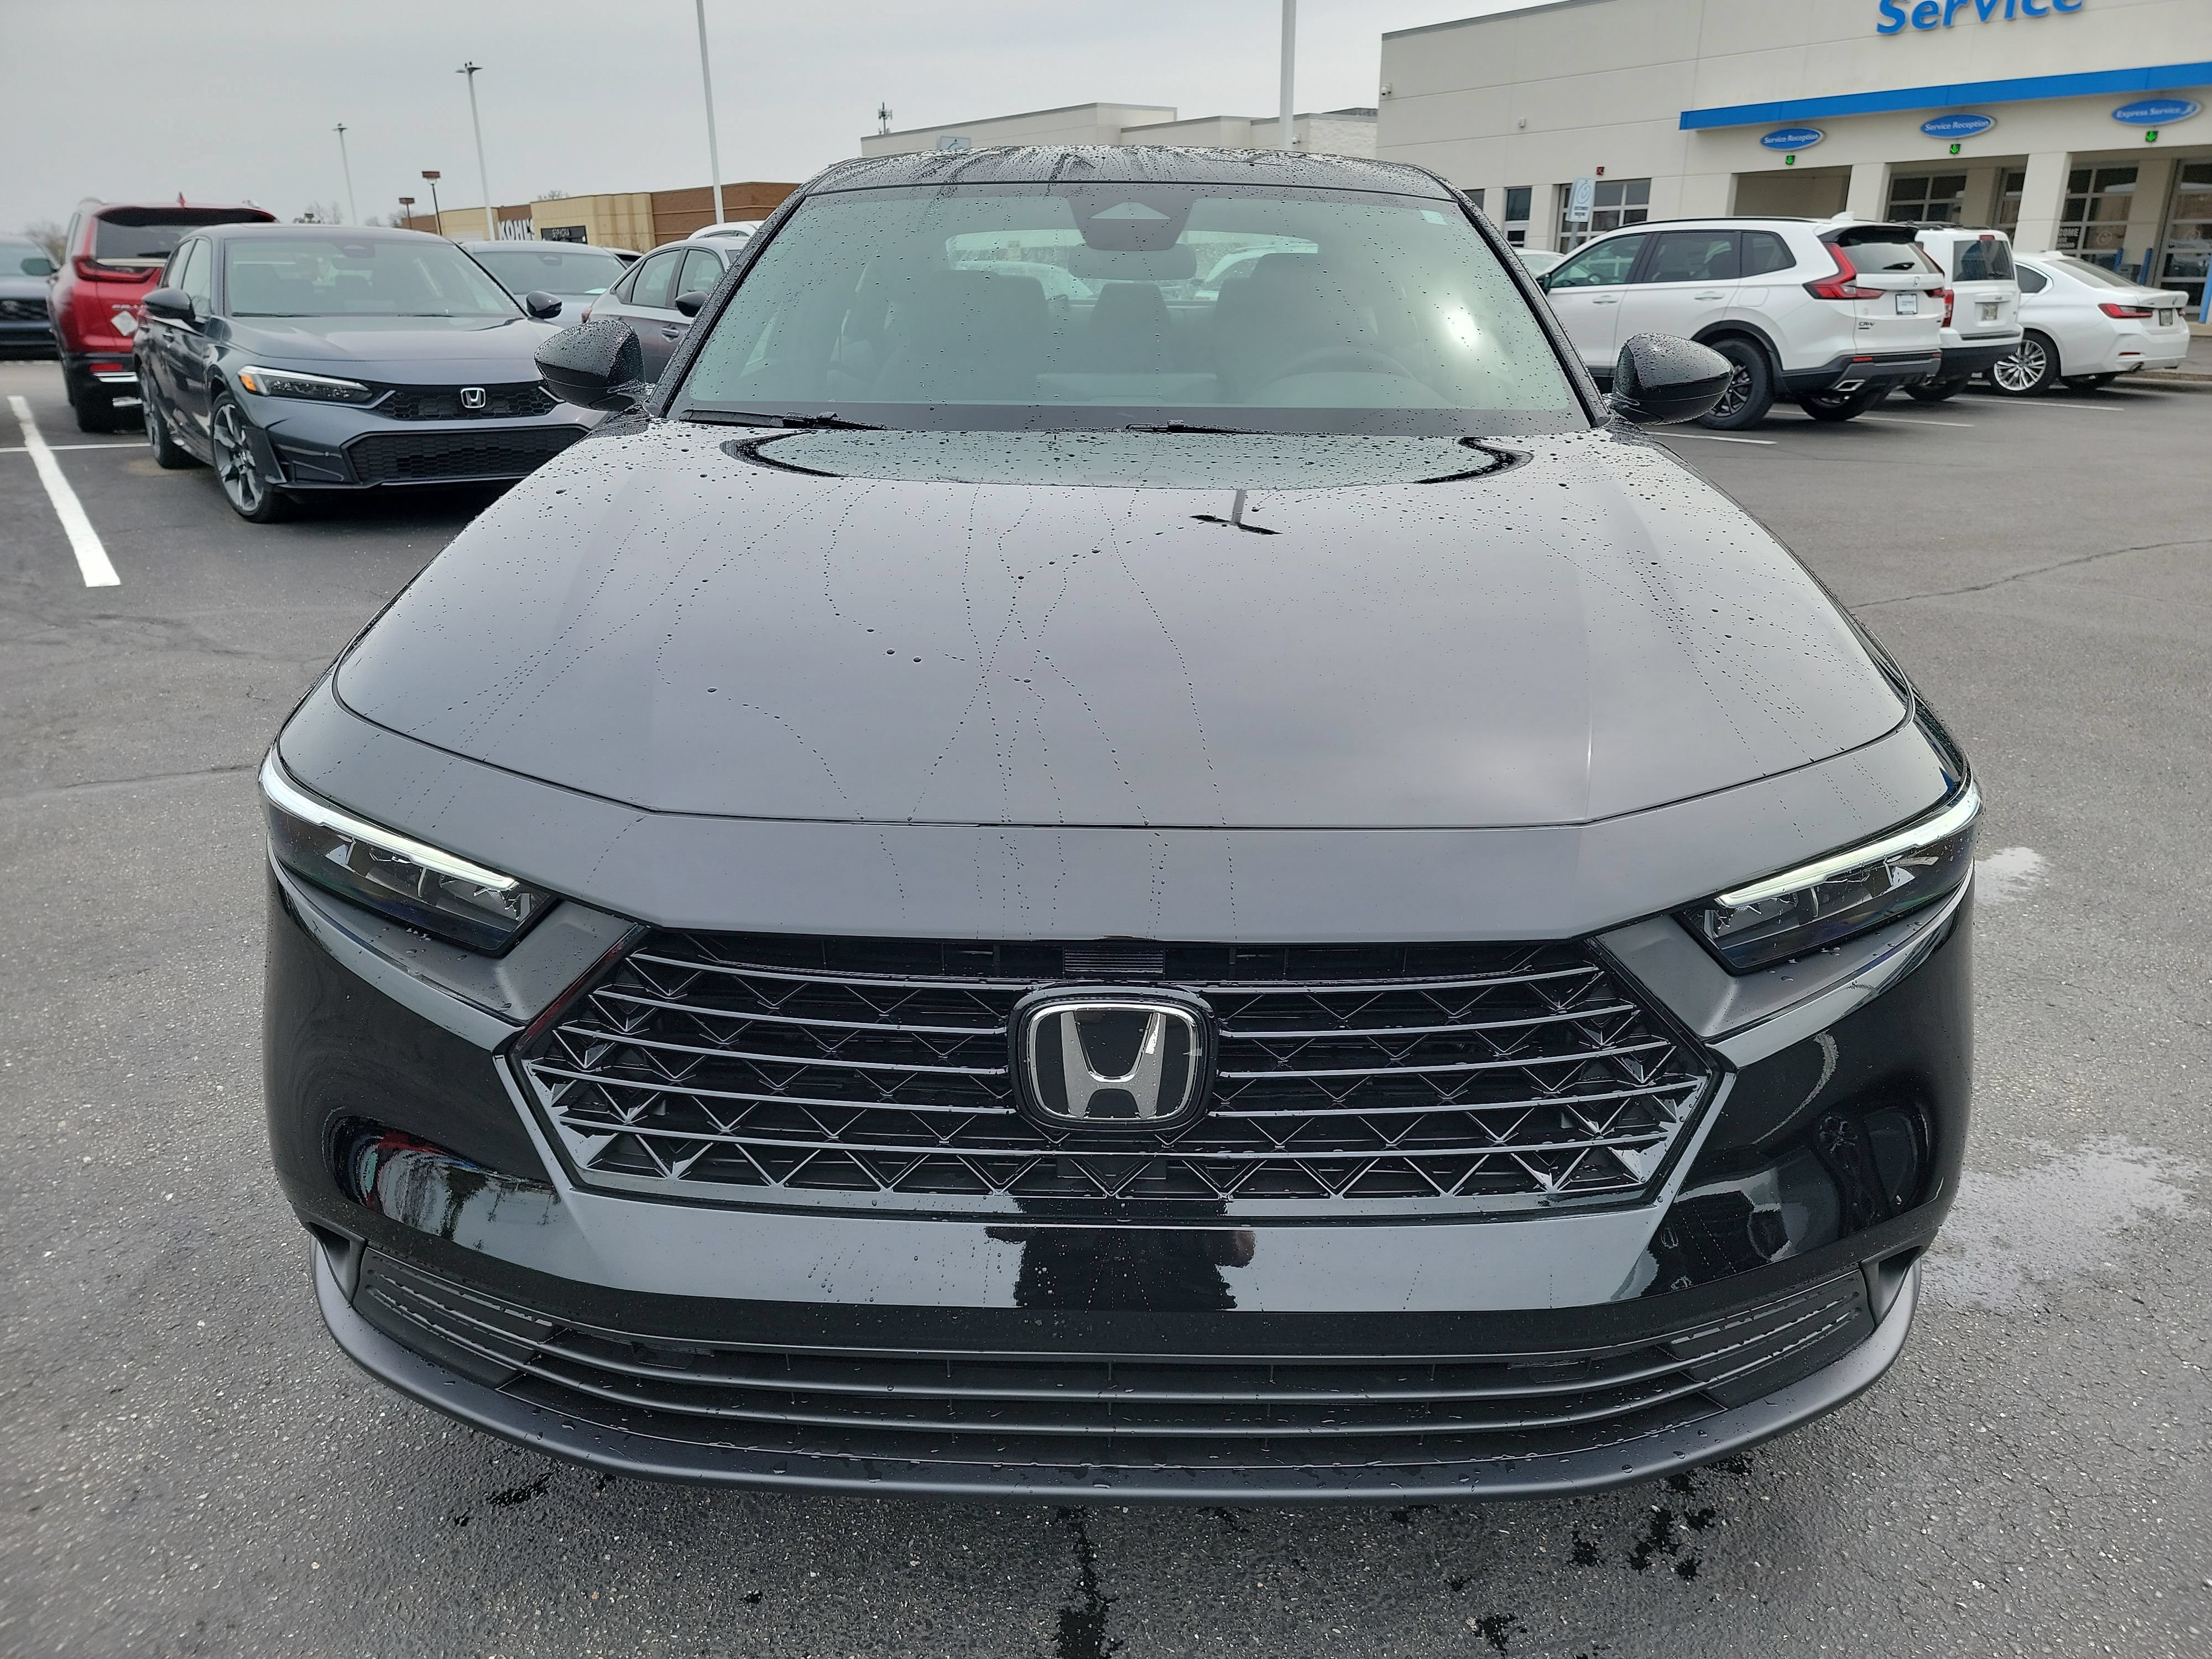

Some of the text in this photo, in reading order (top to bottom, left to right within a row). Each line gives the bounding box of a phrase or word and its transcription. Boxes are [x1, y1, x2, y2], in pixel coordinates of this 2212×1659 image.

[2116, 107, 2180, 118] Express Service
[1924, 121, 1990, 131] Service Reception
[1787, 134, 1819, 142] Reception
